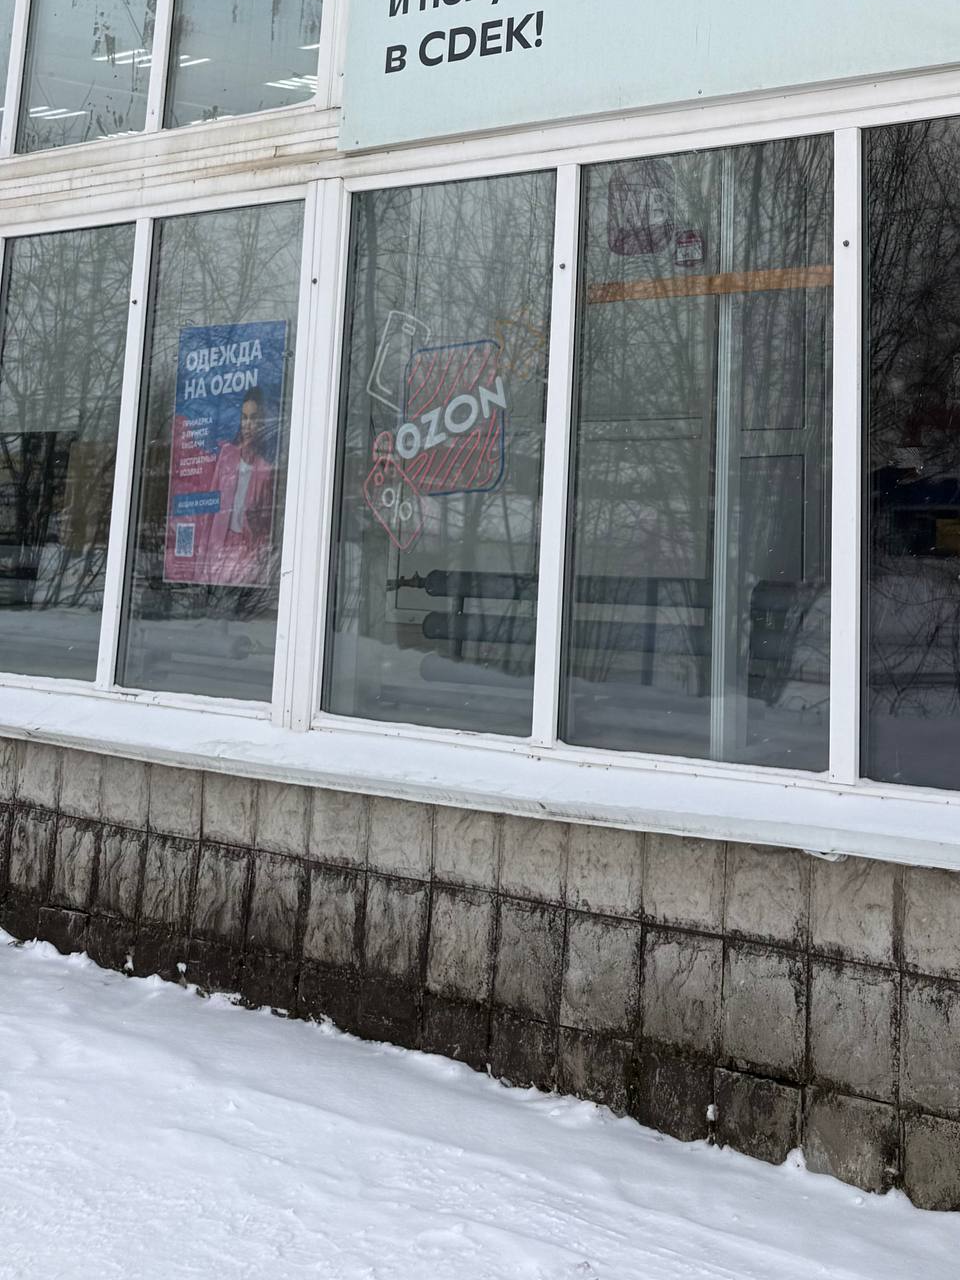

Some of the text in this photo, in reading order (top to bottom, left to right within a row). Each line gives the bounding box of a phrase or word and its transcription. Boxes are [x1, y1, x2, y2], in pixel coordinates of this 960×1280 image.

[384, 10, 544, 74] в CDEK!
[185, 339, 263, 373] ОДЕЖДА
[184, 369, 258, 401] НА OZON
[396, 376, 507, 459] OZON
